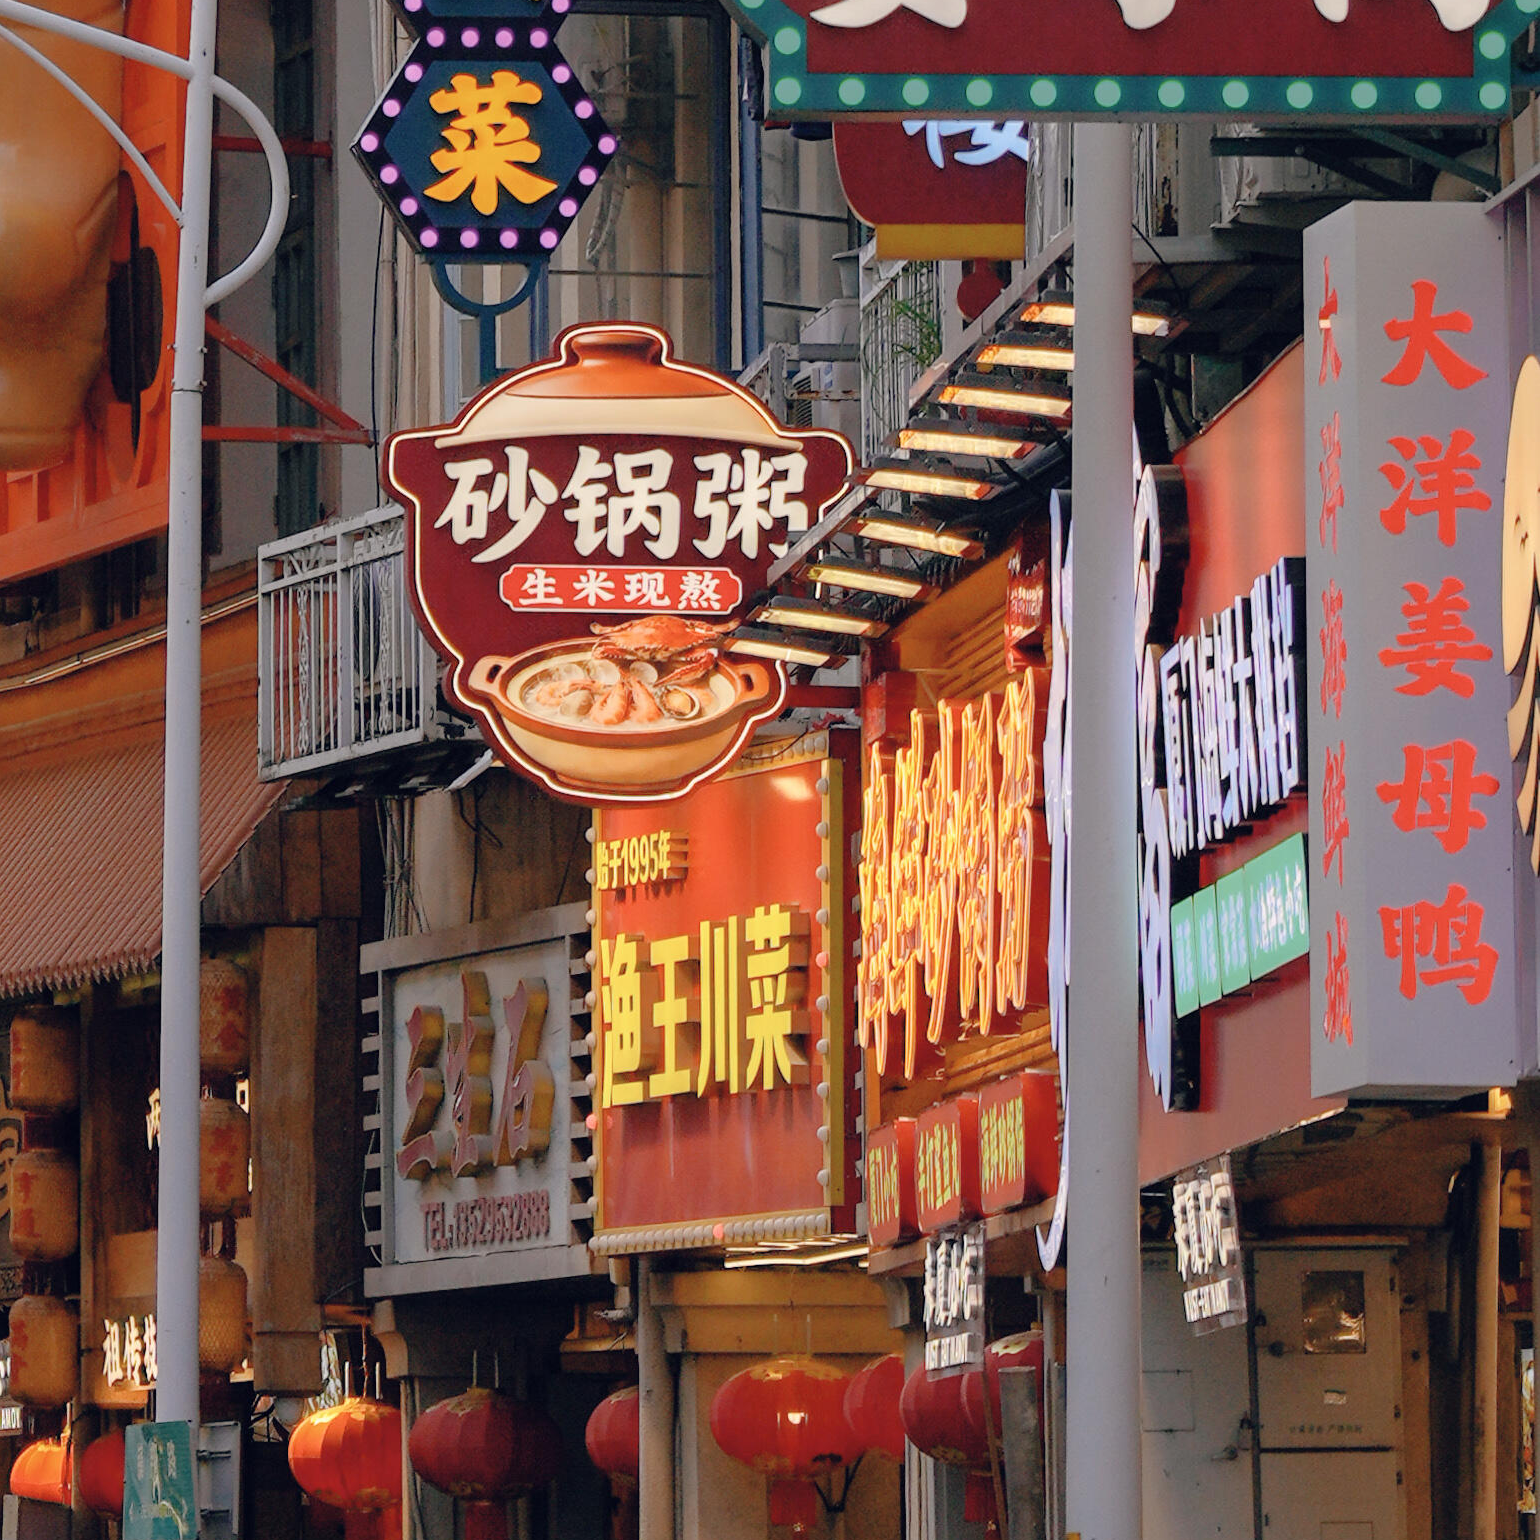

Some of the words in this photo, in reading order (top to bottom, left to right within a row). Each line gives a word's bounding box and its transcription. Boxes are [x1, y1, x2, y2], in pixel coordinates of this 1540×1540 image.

[434, 447, 813, 564] 砂锅粥
[519, 570, 725, 611] 生米现熬
[1316, 254, 1356, 1050] 大洋海鲜城
[1376, 279, 1501, 1008] 大洋姜母鸭
[600, 903, 793, 1109] 渔王川菜
